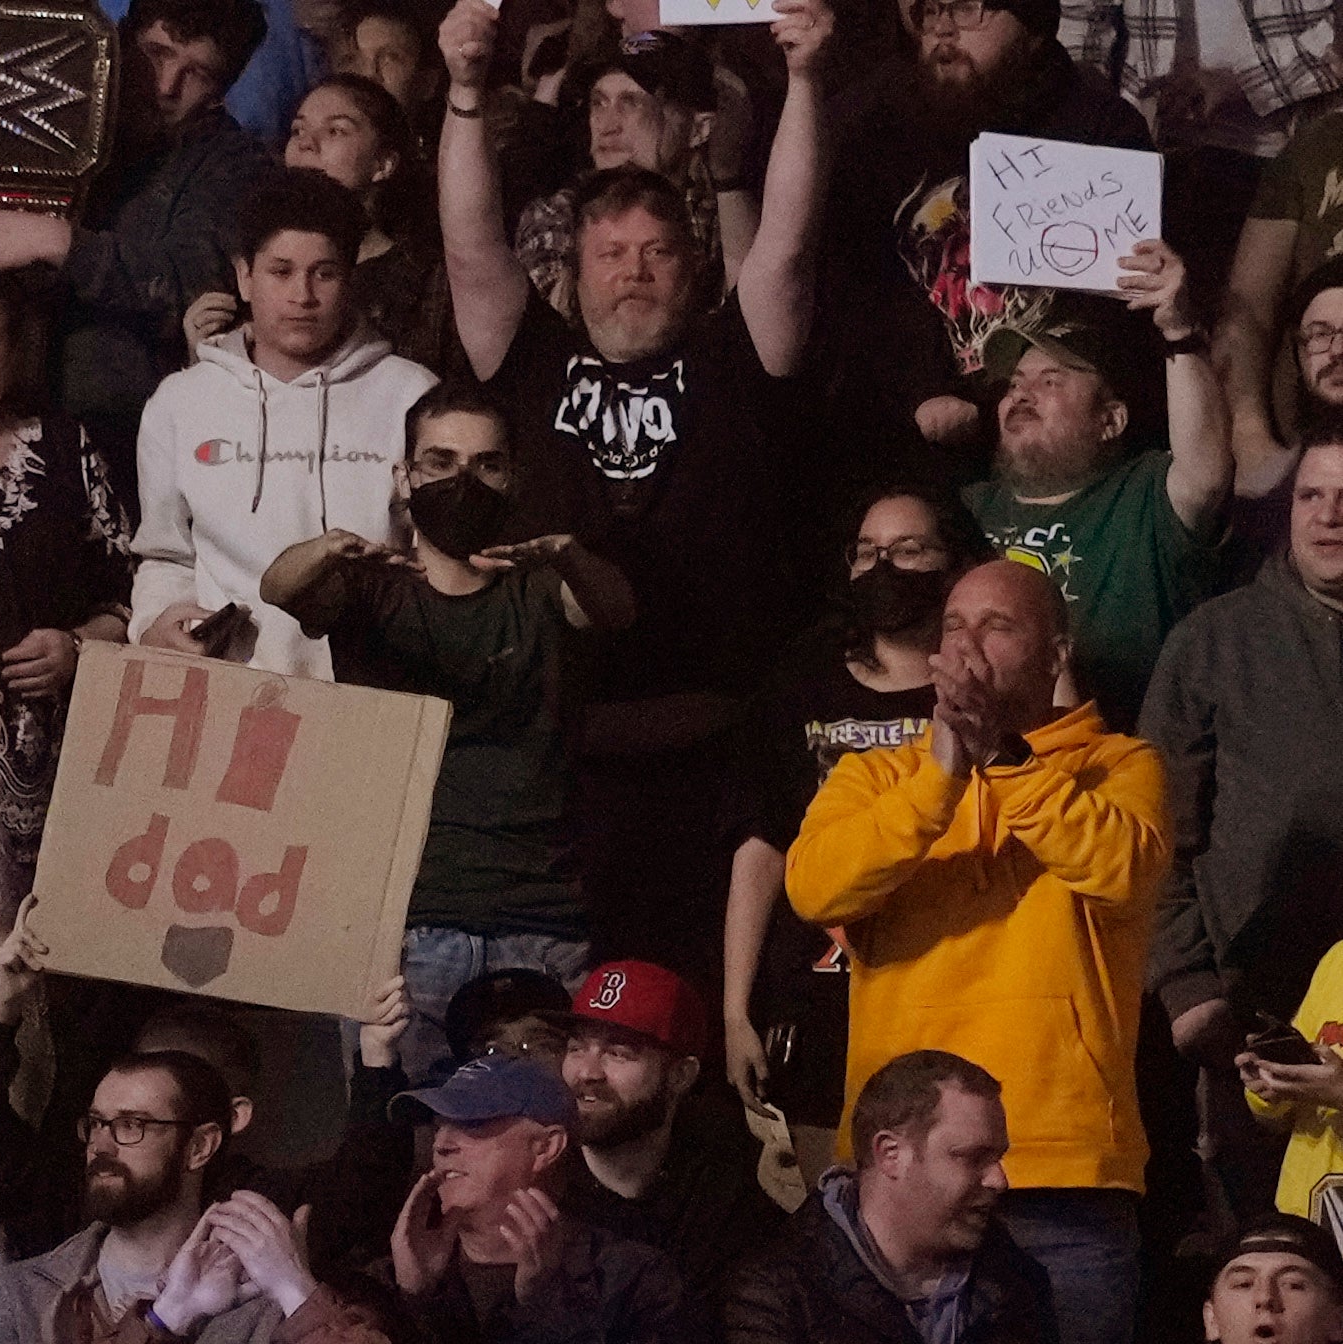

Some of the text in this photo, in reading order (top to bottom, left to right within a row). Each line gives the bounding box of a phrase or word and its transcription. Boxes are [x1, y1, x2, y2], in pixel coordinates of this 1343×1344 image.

[987, 145, 1053, 190] HI
[1104, 198, 1149, 249] ME
[105, 812, 309, 938] dad
